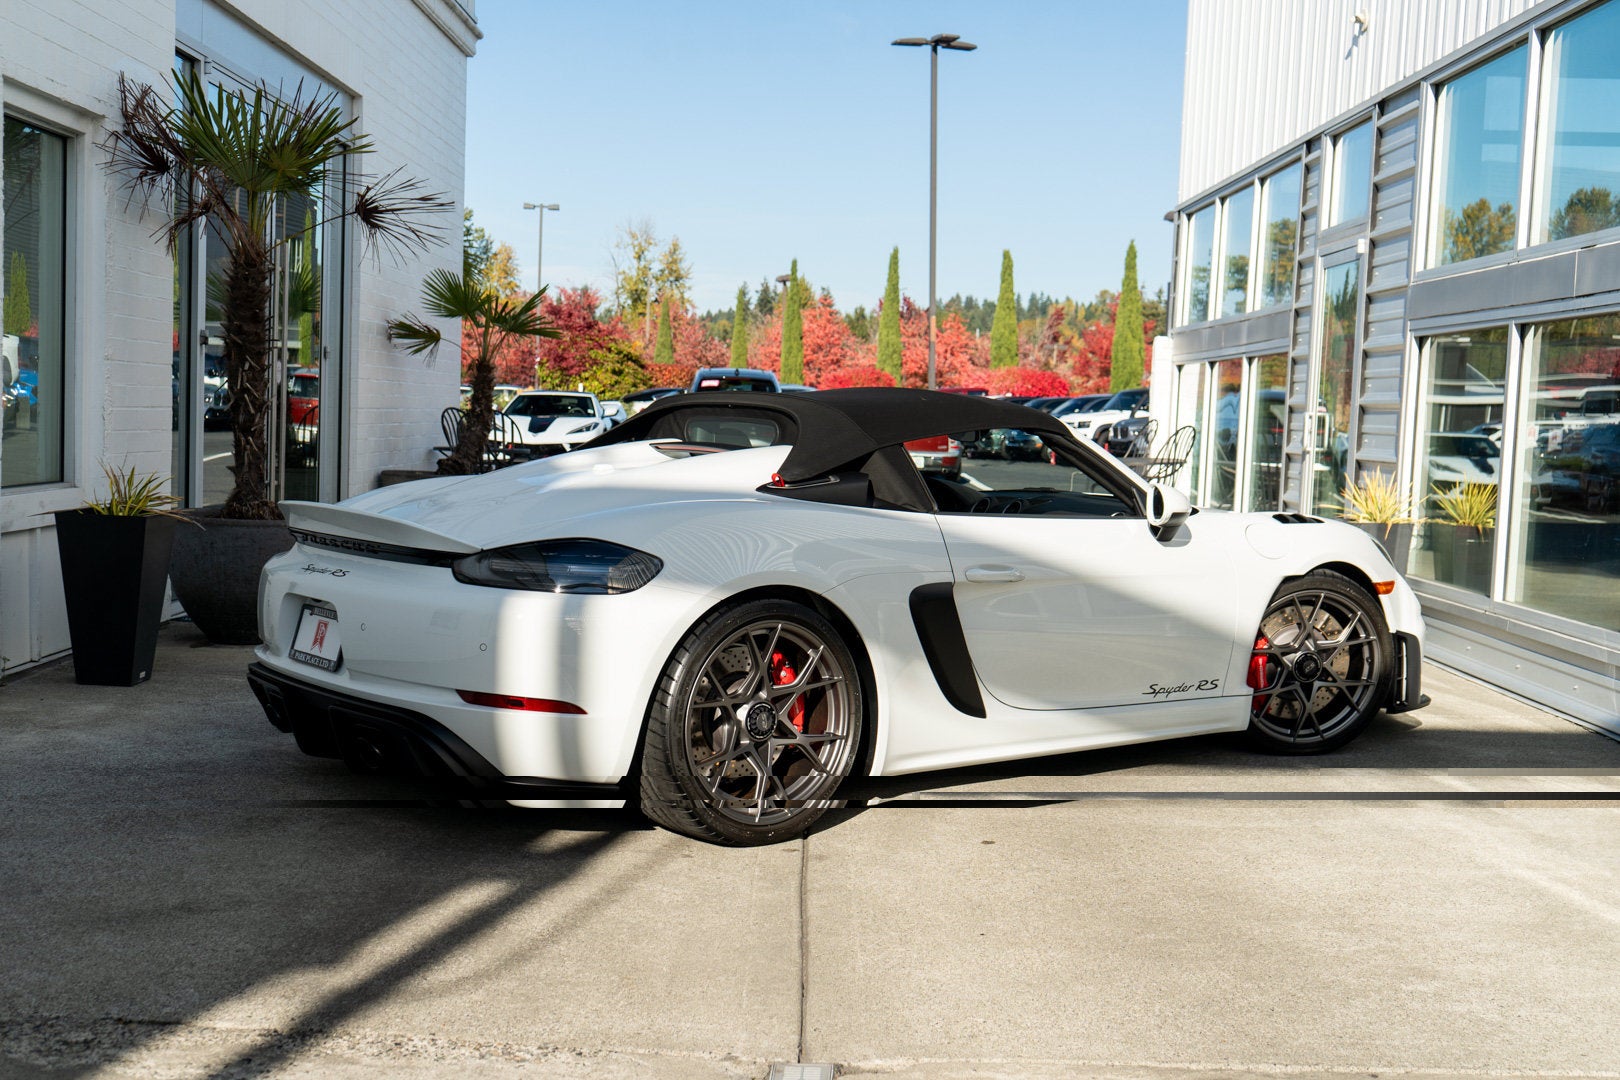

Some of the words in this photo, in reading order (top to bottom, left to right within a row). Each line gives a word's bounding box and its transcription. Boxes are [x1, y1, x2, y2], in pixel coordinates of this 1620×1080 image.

[329, 568, 351, 578] RS
[304, 654, 320, 666] PLACE
[1142, 682, 1195, 698] Spyder
[1195, 679, 1220, 691] RS
